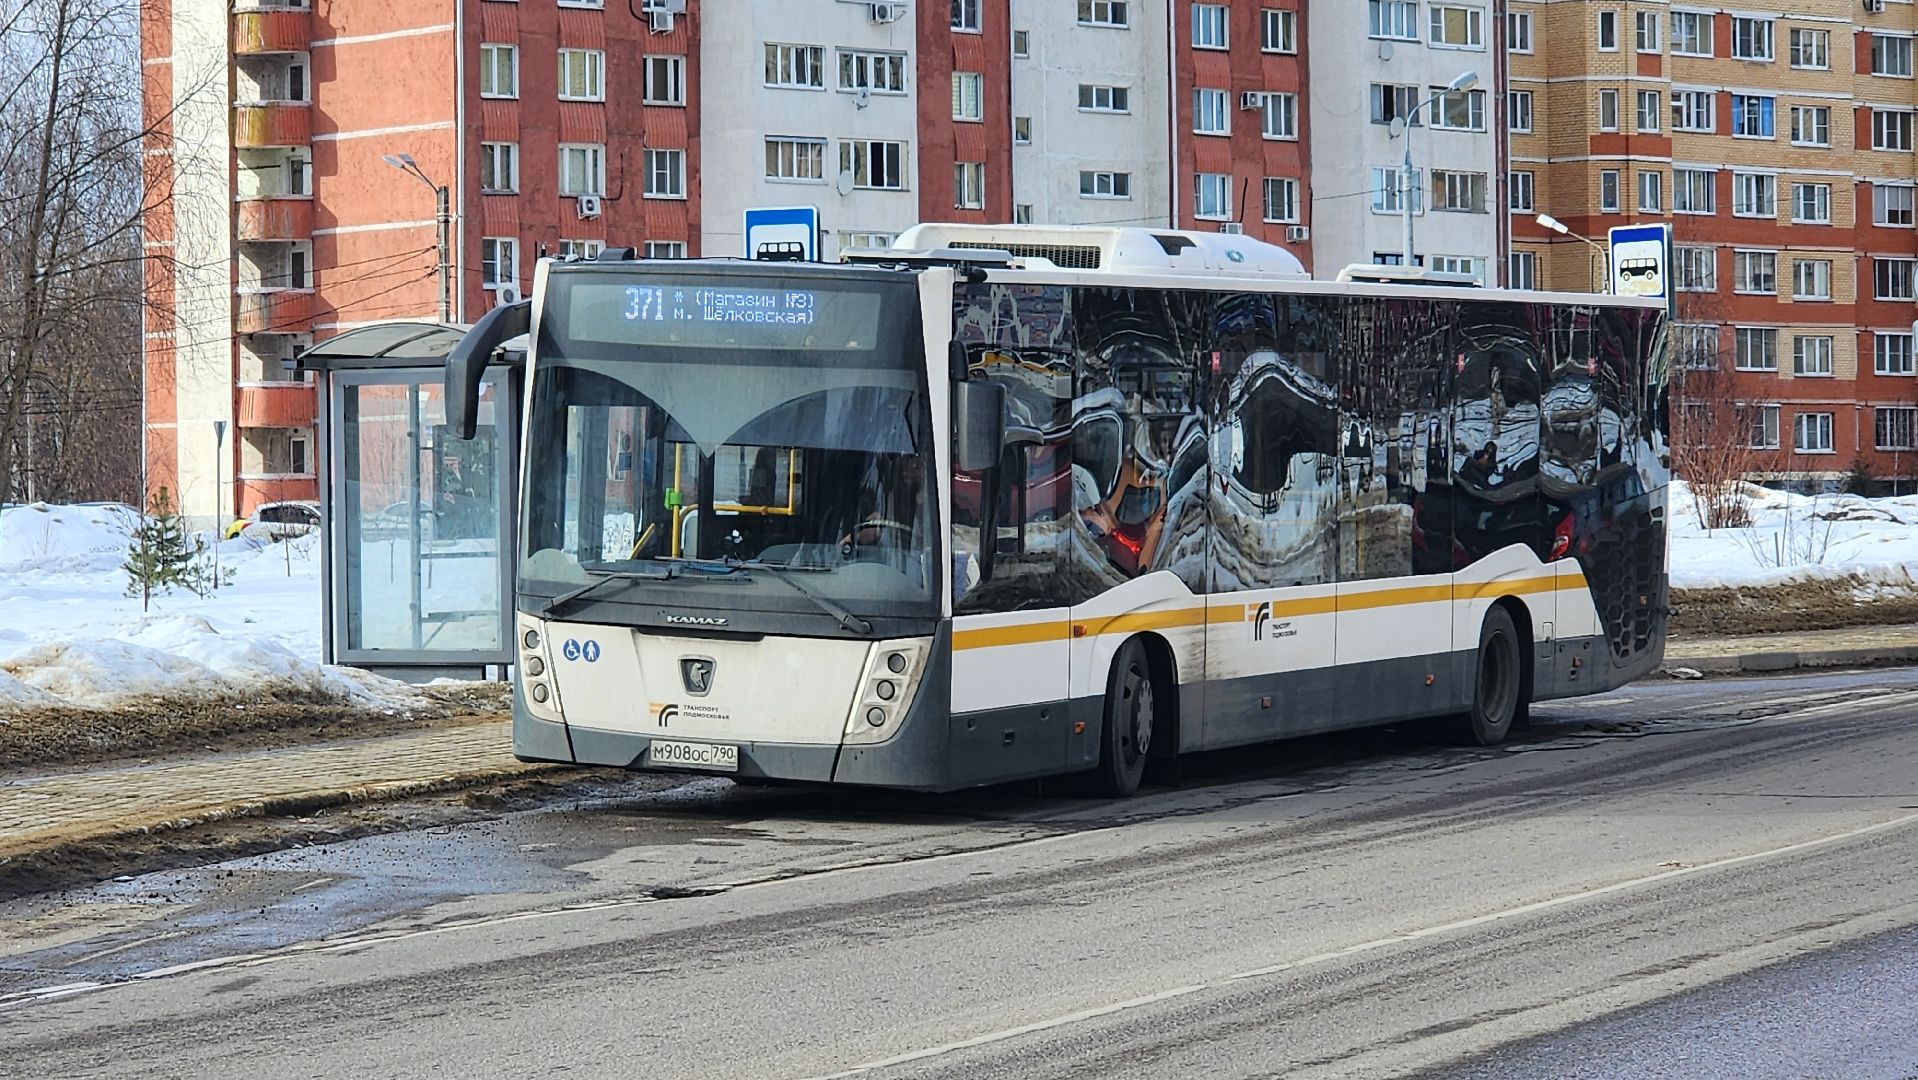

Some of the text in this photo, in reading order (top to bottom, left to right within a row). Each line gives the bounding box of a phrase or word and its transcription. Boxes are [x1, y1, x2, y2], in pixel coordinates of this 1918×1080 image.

[625, 287, 663, 321] 371
[696, 290, 776, 308] (Магазин
[683, 704, 719, 713] ТРАНСПОРТ
[712, 746, 734, 760] 790
